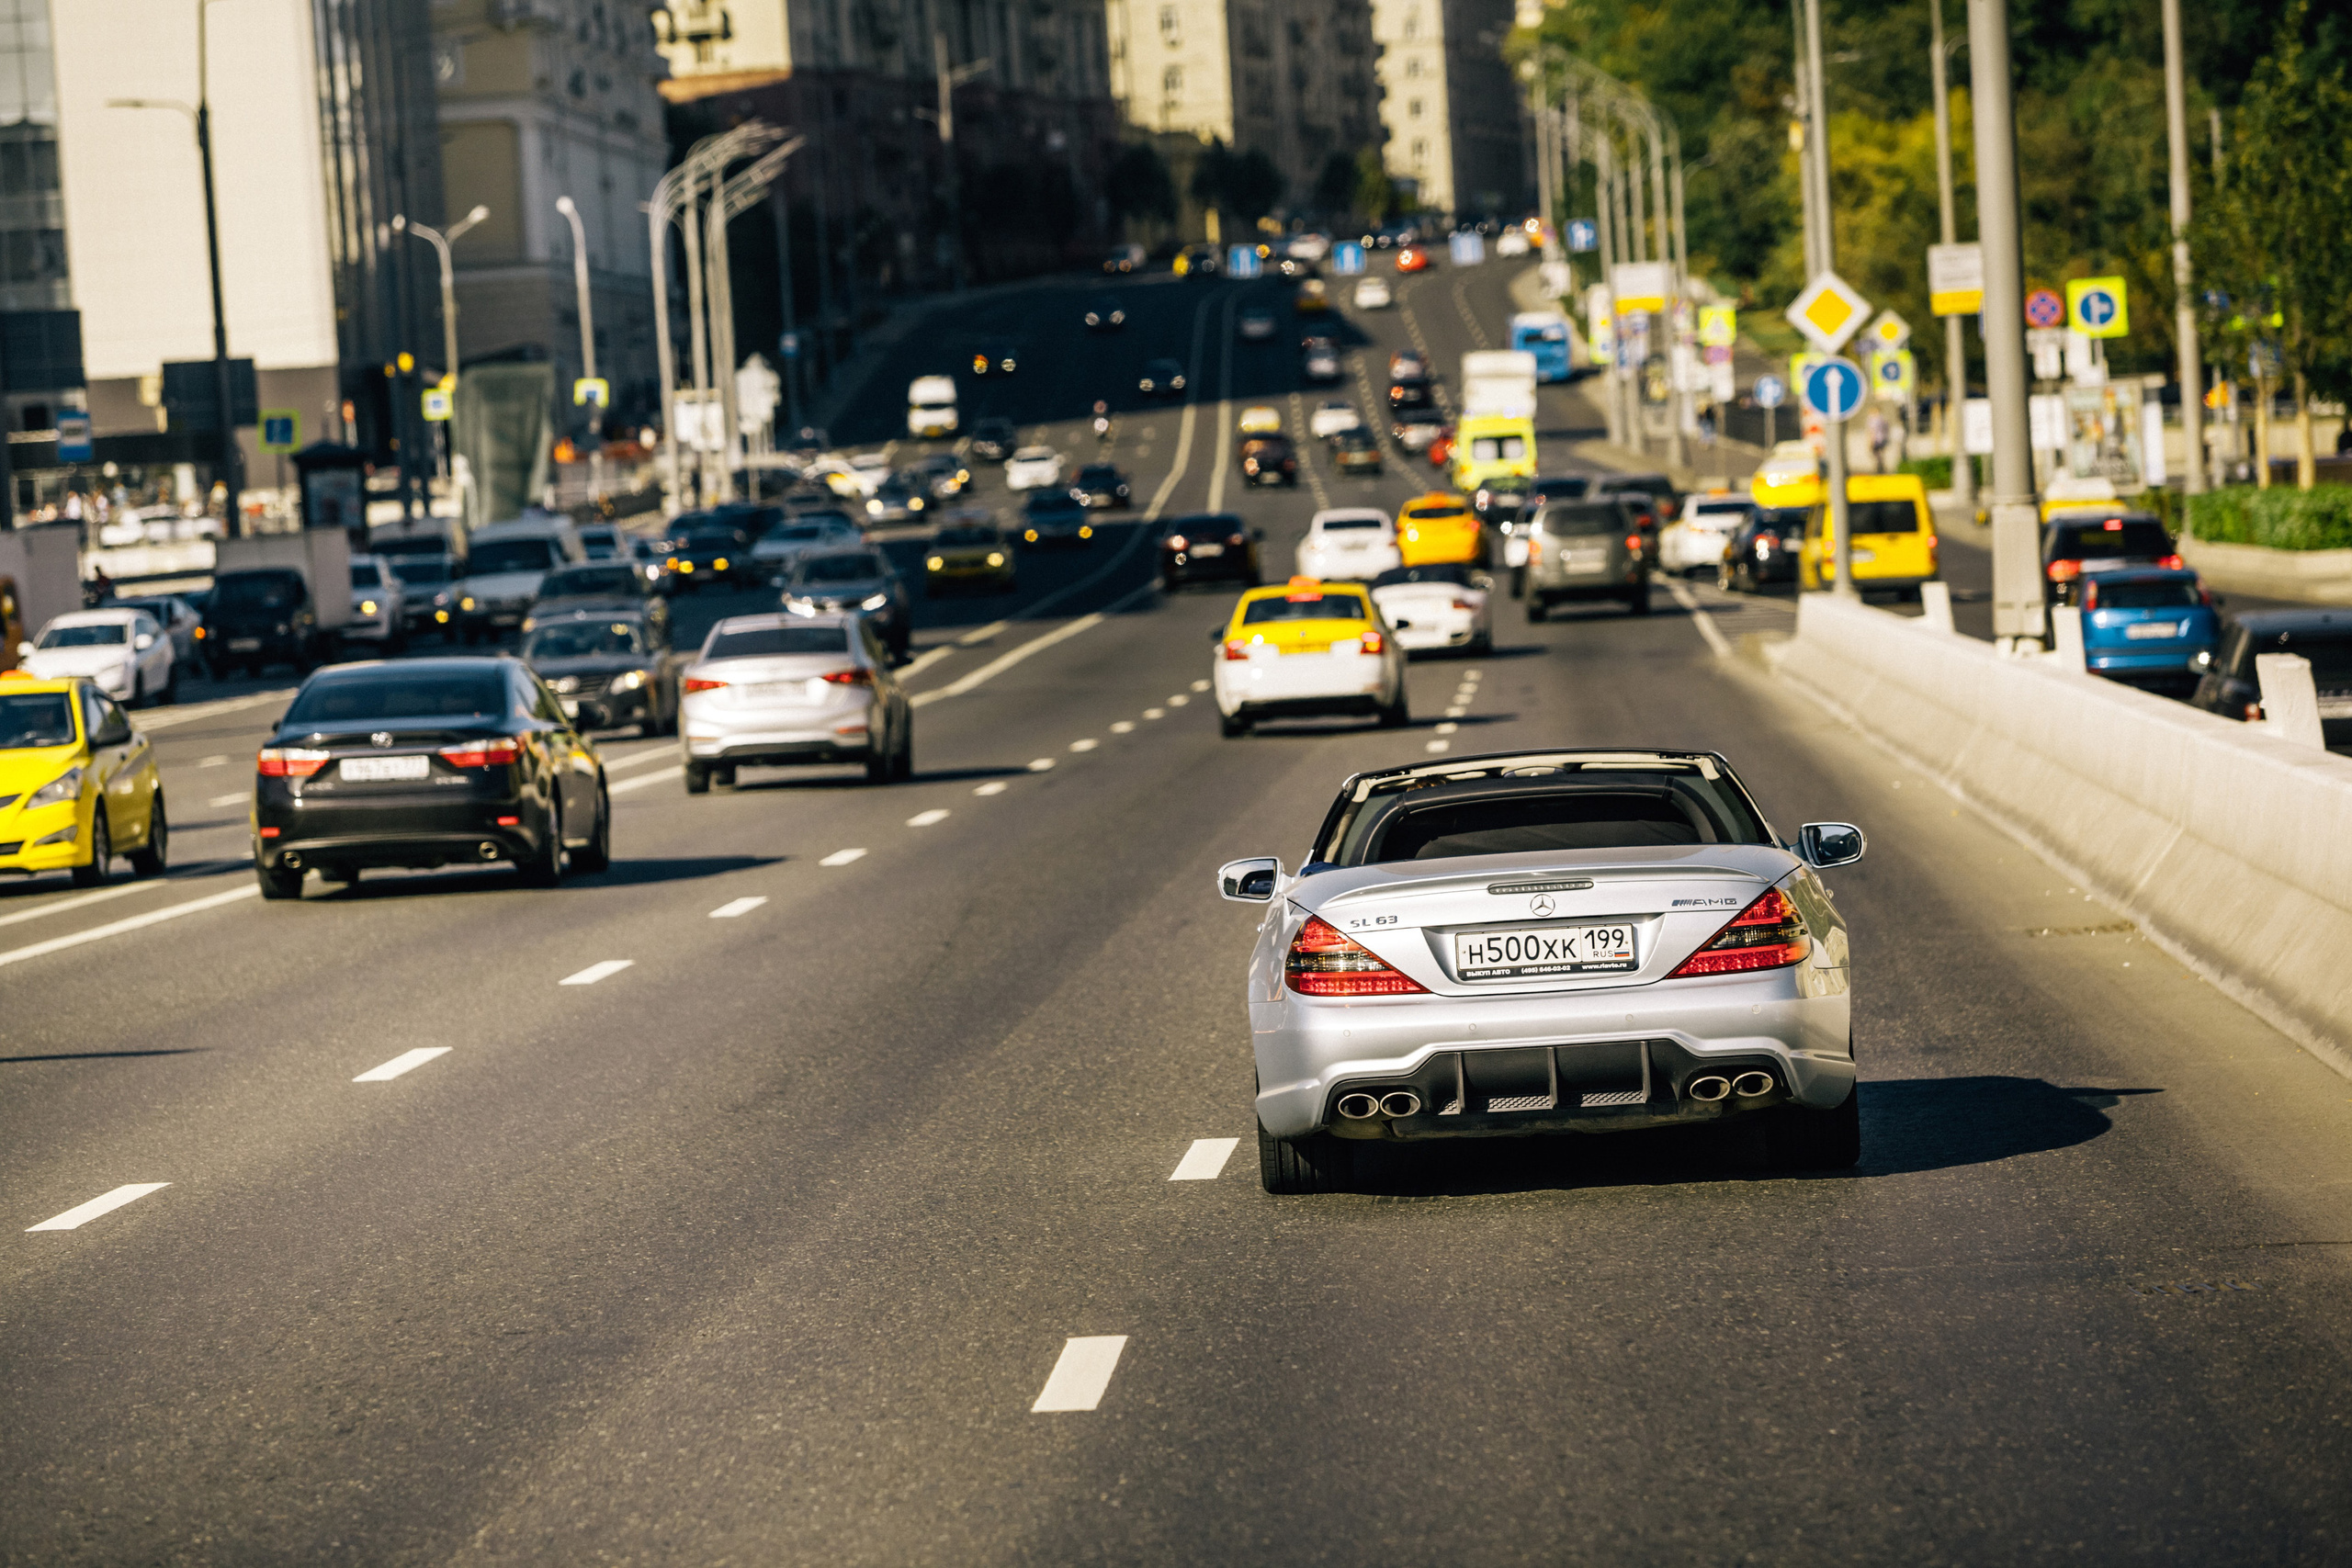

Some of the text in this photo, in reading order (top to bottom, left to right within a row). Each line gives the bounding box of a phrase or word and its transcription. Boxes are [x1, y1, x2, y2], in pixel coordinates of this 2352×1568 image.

[1691, 897, 1737, 907] AMG
[1350, 915, 1398, 929] SL 63
[1584, 929, 1624, 950] 199
[1593, 950, 1614, 958] RUS
[1466, 969, 1491, 977] ВЫКУП
